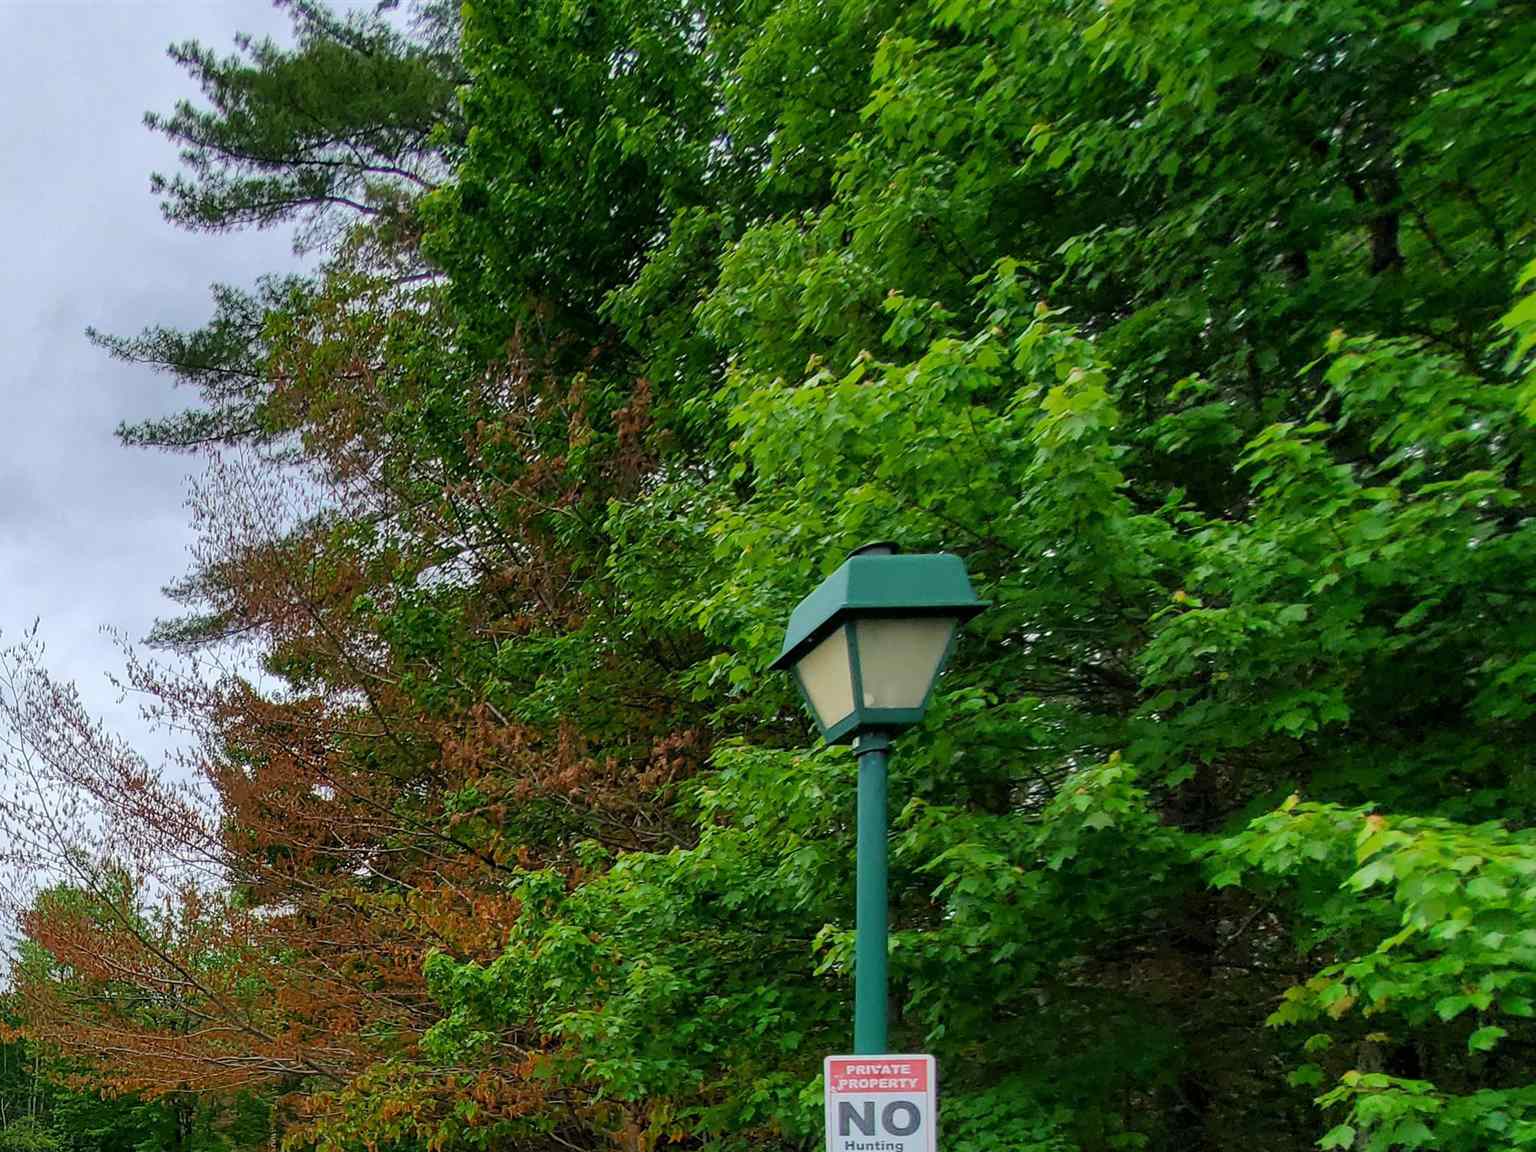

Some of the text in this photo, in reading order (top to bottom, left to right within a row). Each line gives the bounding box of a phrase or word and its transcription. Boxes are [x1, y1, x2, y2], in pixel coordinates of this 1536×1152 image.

[846, 1064, 912, 1075] PRIVATE
[838, 1078, 918, 1089] PROPERTY
[839, 1100, 921, 1137] NO
[844, 1141, 904, 1152] Hunting
